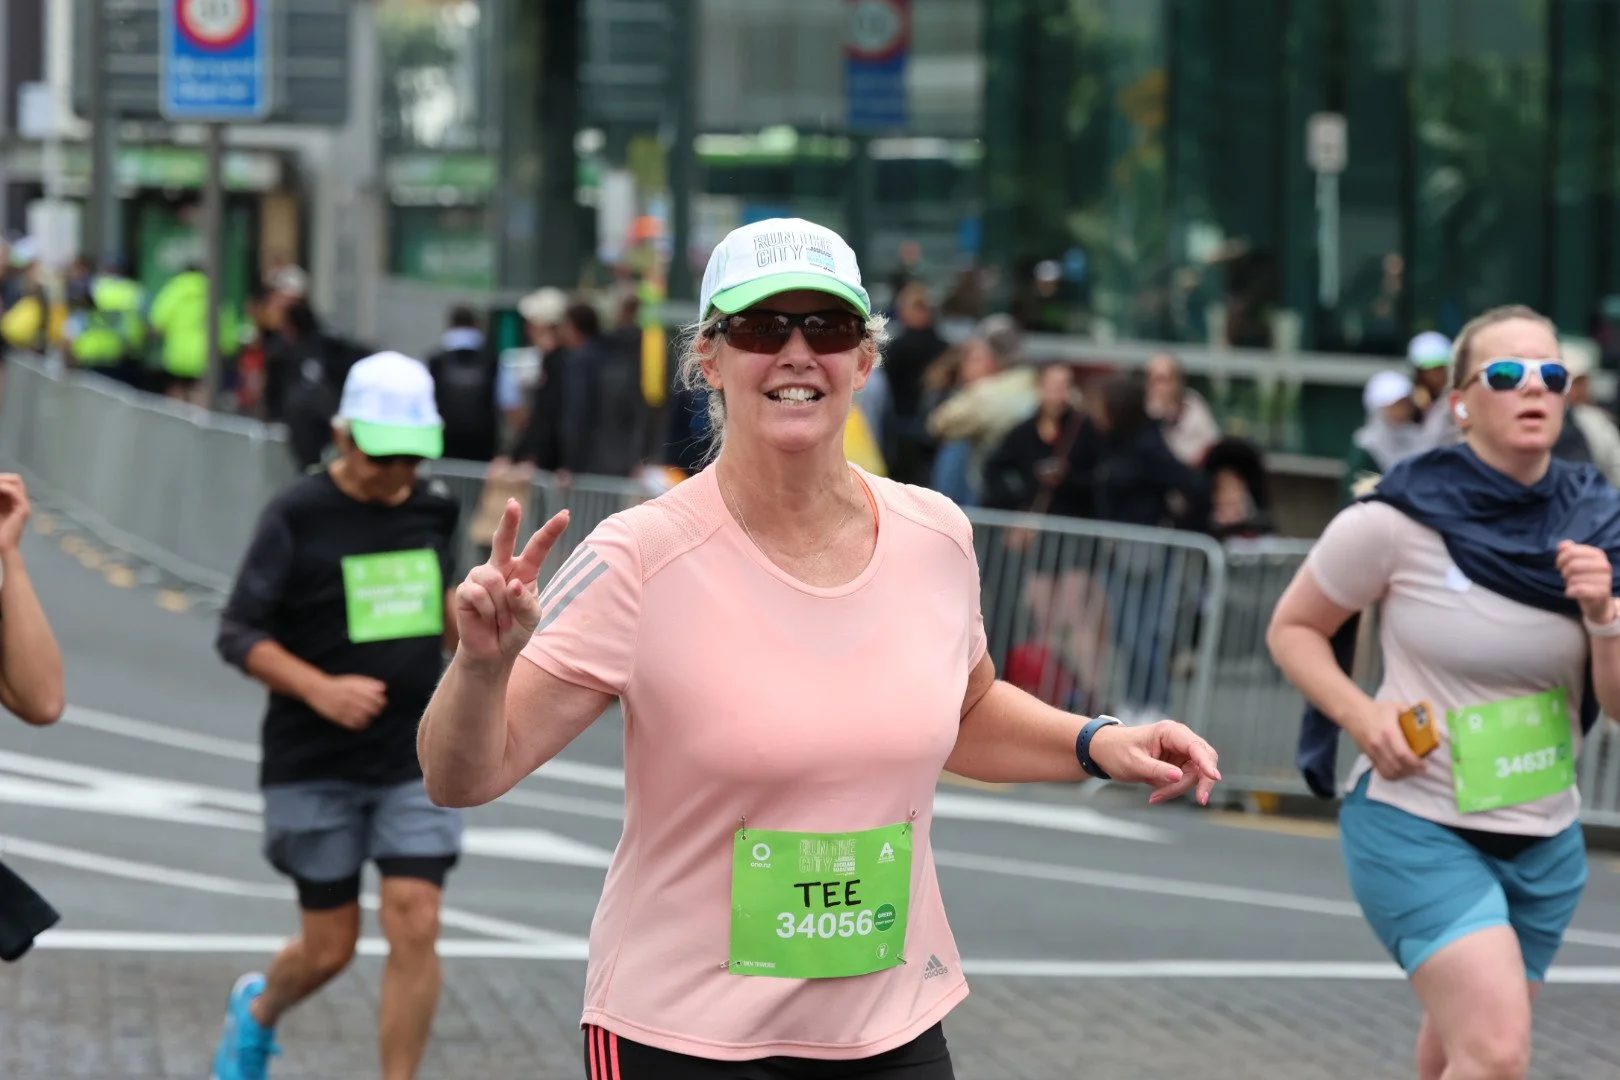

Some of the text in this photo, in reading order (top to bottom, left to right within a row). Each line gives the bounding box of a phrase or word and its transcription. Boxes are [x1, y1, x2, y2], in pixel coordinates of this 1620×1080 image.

[754, 232, 796, 251] RUN
[756, 245, 804, 268] CITY
[794, 879, 862, 908] TEE
[776, 909, 873, 938] 34056
[924, 966, 949, 980] adidas
